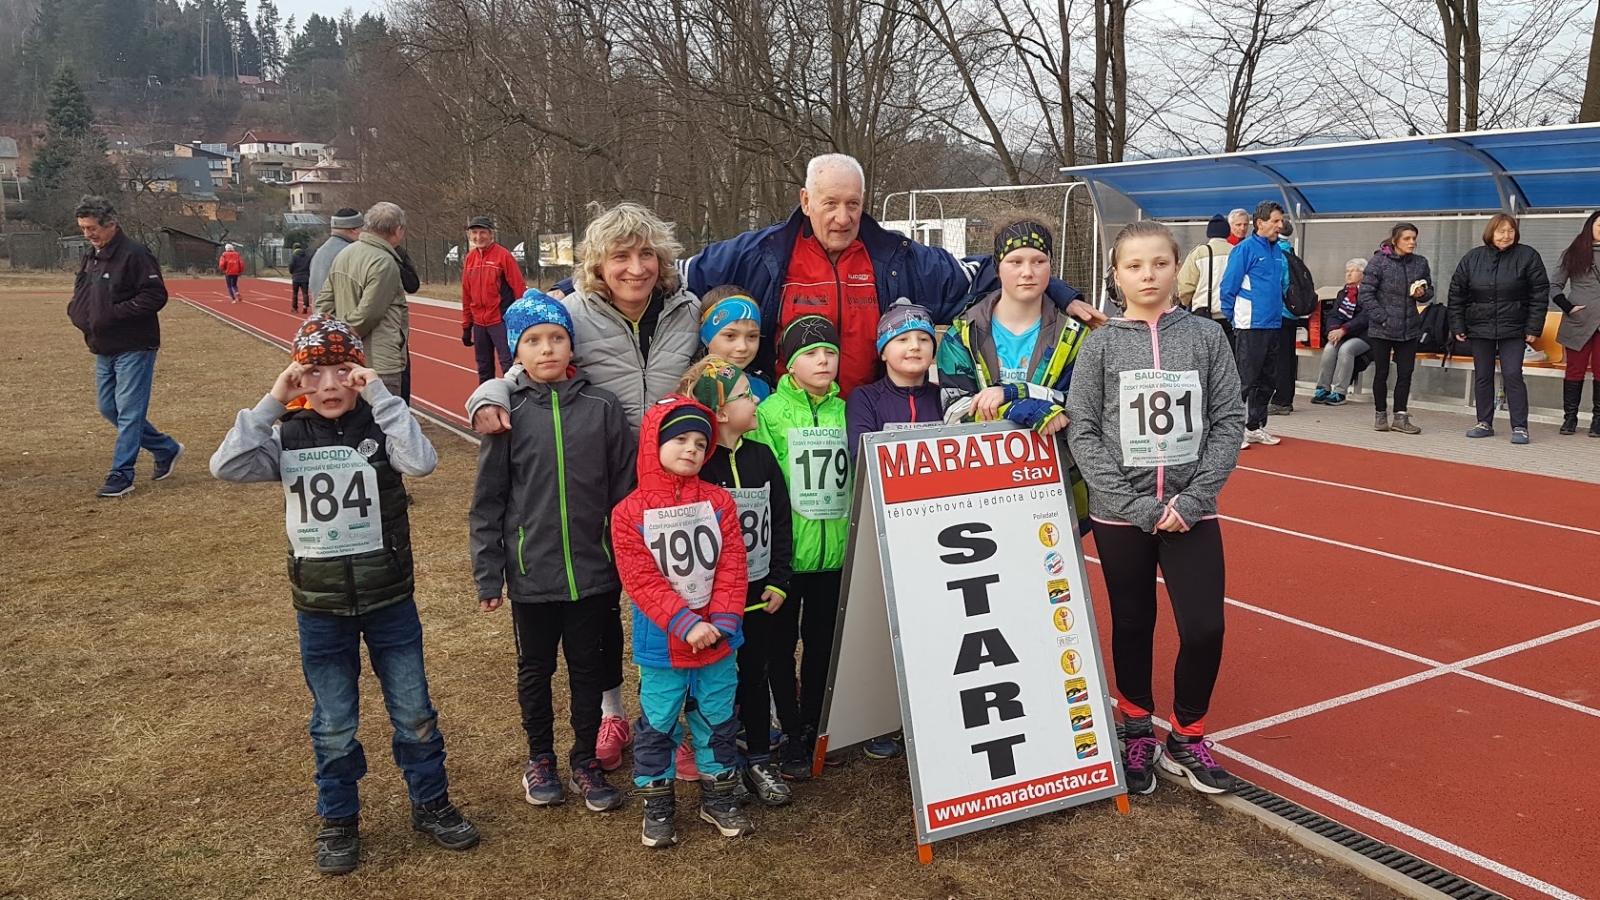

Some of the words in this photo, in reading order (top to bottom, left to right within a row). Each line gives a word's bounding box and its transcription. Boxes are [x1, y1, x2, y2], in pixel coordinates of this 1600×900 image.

[1130, 390, 1193, 435] 181
[795, 448, 848, 490] 179
[877, 430, 1056, 478] MARATON
[1012, 465, 1053, 482] stav
[289, 470, 372, 523] 184
[887, 498, 973, 518] tělovýchovná
[979, 492, 1025, 509] jednota
[1030, 486, 1063, 501] Úpice
[651, 524, 719, 577] 190
[740, 505, 770, 552] 86
[937, 521, 1027, 781] START
[934, 768, 1109, 822] www.maratonstav.cz
